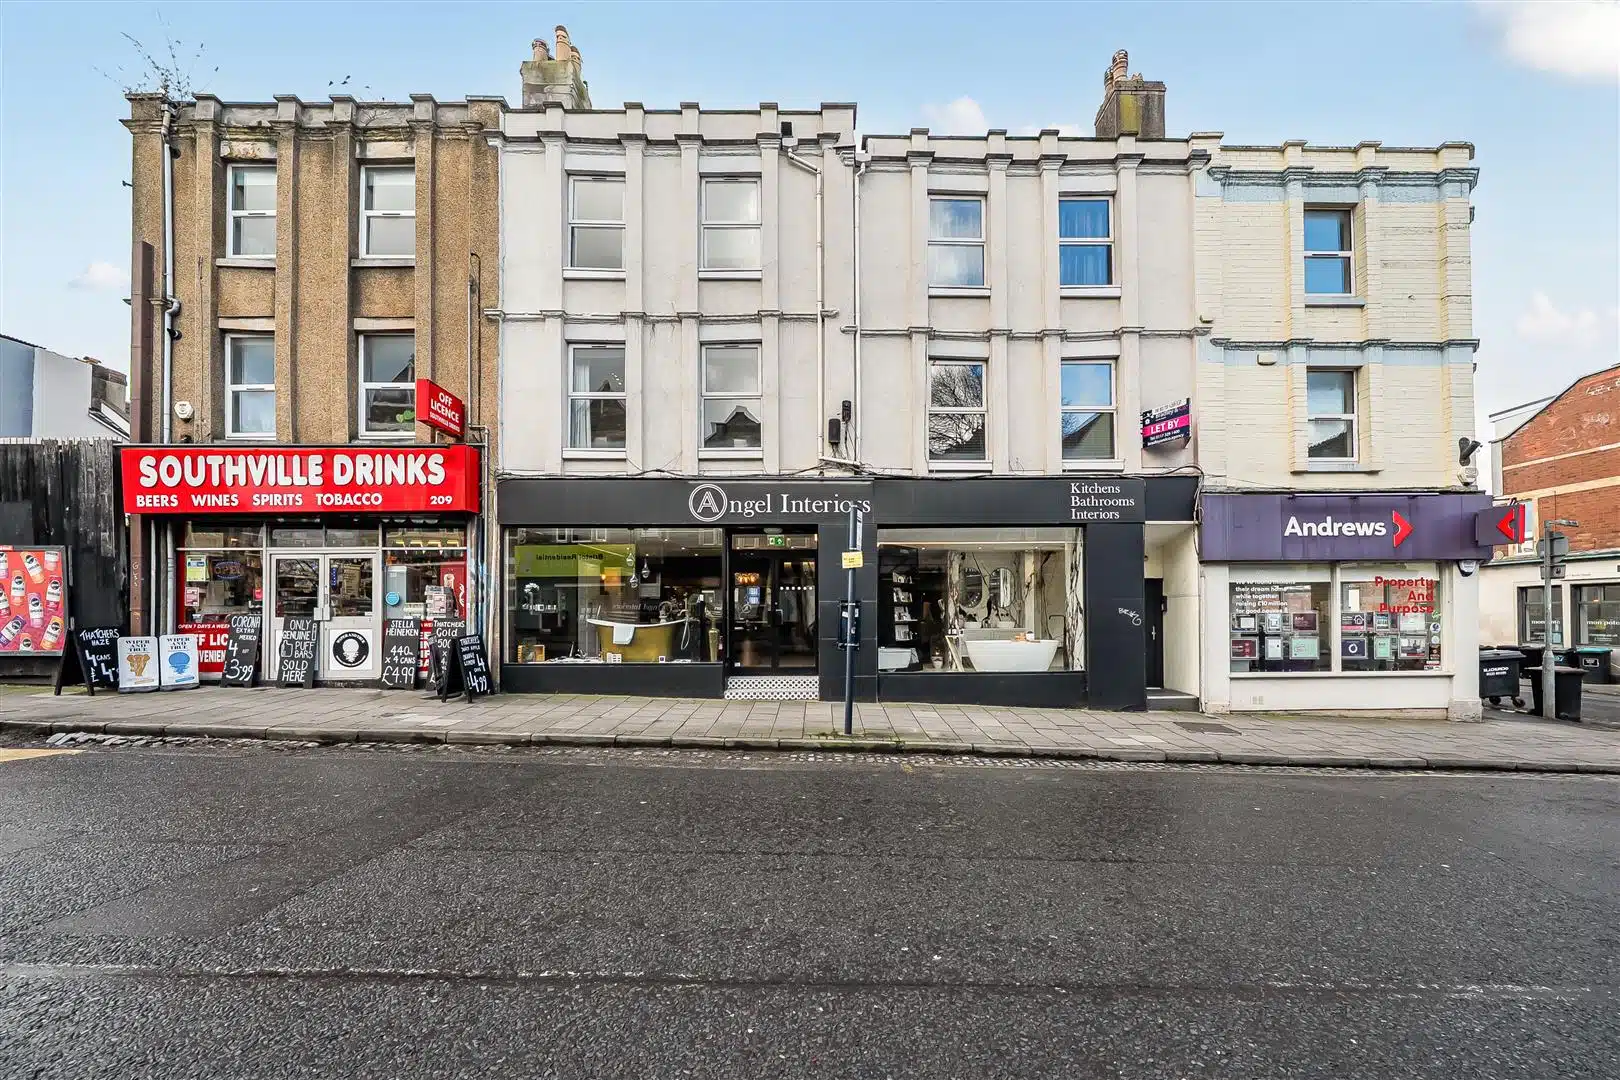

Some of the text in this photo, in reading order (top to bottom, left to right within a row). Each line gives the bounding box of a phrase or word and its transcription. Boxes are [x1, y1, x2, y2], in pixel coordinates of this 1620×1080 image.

[439, 392, 452, 407] OFF
[430, 398, 460, 423] LICENCE
[1150, 418, 1180, 434] LET BY
[139, 453, 446, 488] SOUTHVILLE DRINKS
[1070, 482, 1121, 494] Kitchens
[136, 493, 453, 508] BEERS WINES SPIRITS TOBACCO 209
[690, 486, 773, 519] Angel
[1070, 495, 1135, 507] Bathrooms
[1070, 508, 1120, 520] Interiors
[1283, 516, 1387, 537] Andrews
[1374, 576, 1434, 589] Property
[1408, 590, 1434, 602] And
[1379, 602, 1434, 616] Purpose
[231, 615, 261, 628] CORONA
[289, 619, 312, 631] ONLY
[390, 620, 414, 629] STELLA
[433, 620, 465, 628] THATCHERS
[80, 628, 120, 641] THATCHERS
[282, 630, 312, 641] GENUINE
[385, 628, 419, 637] HEINEKEN
[436, 628, 458, 637] Gold
[209, 633, 229, 646] LIC
[228, 639, 239, 657] 4
[294, 641, 316, 651] PUFF
[85, 649, 97, 667] 4
[96, 653, 112, 661] CANS
[199, 650, 227, 662] VENIEN
[294, 650, 314, 659] BARS
[400, 656, 416, 665] CANS
[281, 659, 309, 671] SOLD
[476, 653, 486, 672] 4
[281, 670, 307, 682] HERE
[381, 665, 415, 686] £4.99
